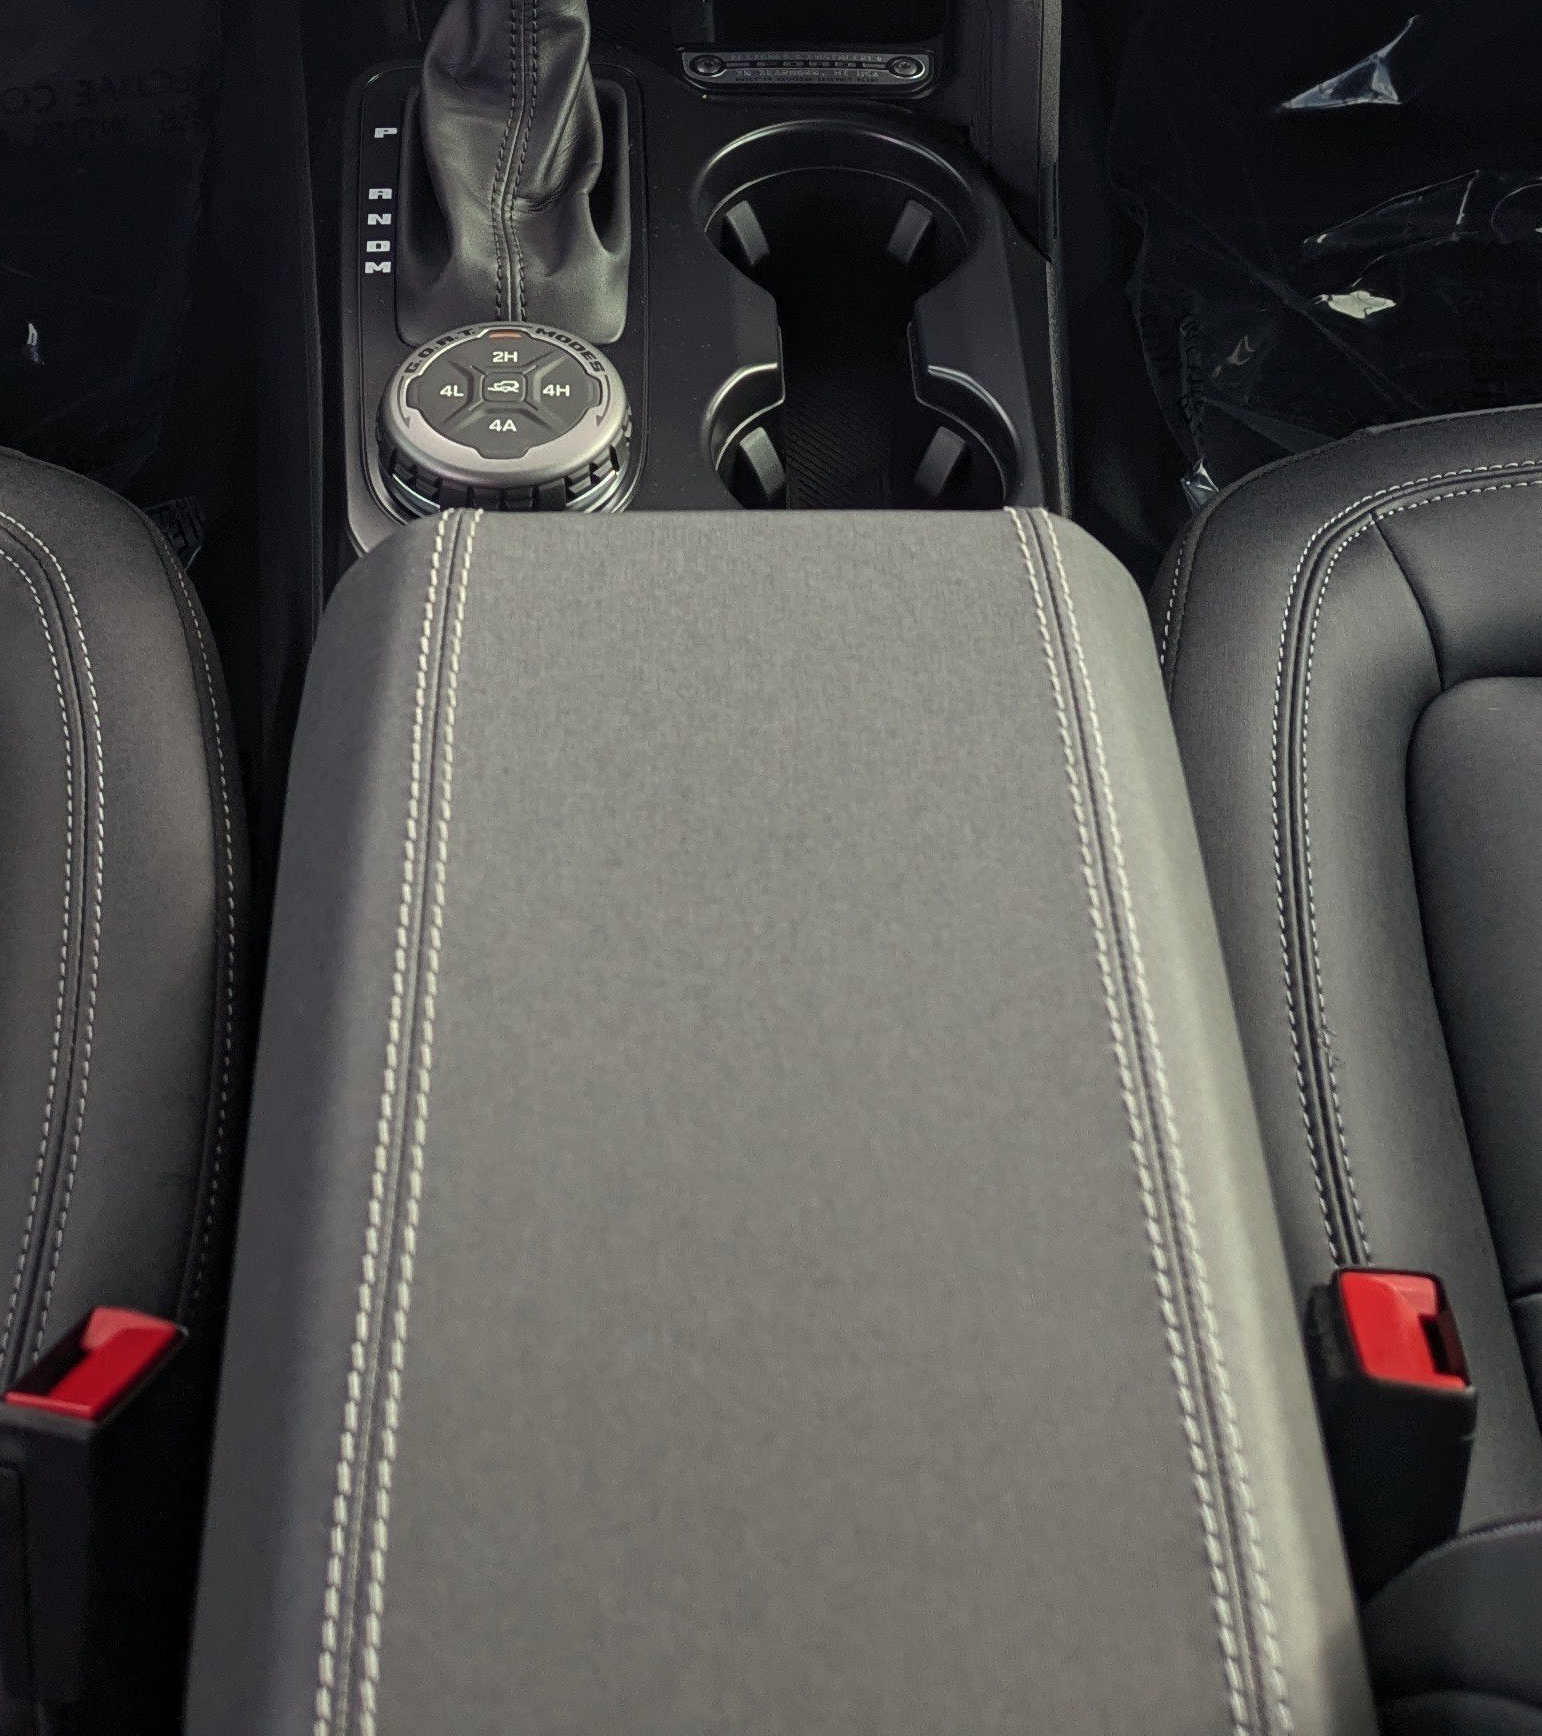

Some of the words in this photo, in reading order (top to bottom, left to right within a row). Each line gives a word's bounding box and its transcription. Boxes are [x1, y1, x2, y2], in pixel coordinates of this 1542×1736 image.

[374, 127, 398, 139] P
[368, 188, 392, 200] R
[367, 213, 392, 225] N
[366, 240, 391, 252] D
[364, 261, 392, 274] M
[534, 326, 607, 374] MODES
[492, 351, 518, 363] 2H
[439, 385, 465, 397] 4L
[542, 385, 570, 397] 4H
[488, 419, 517, 432] 4A
